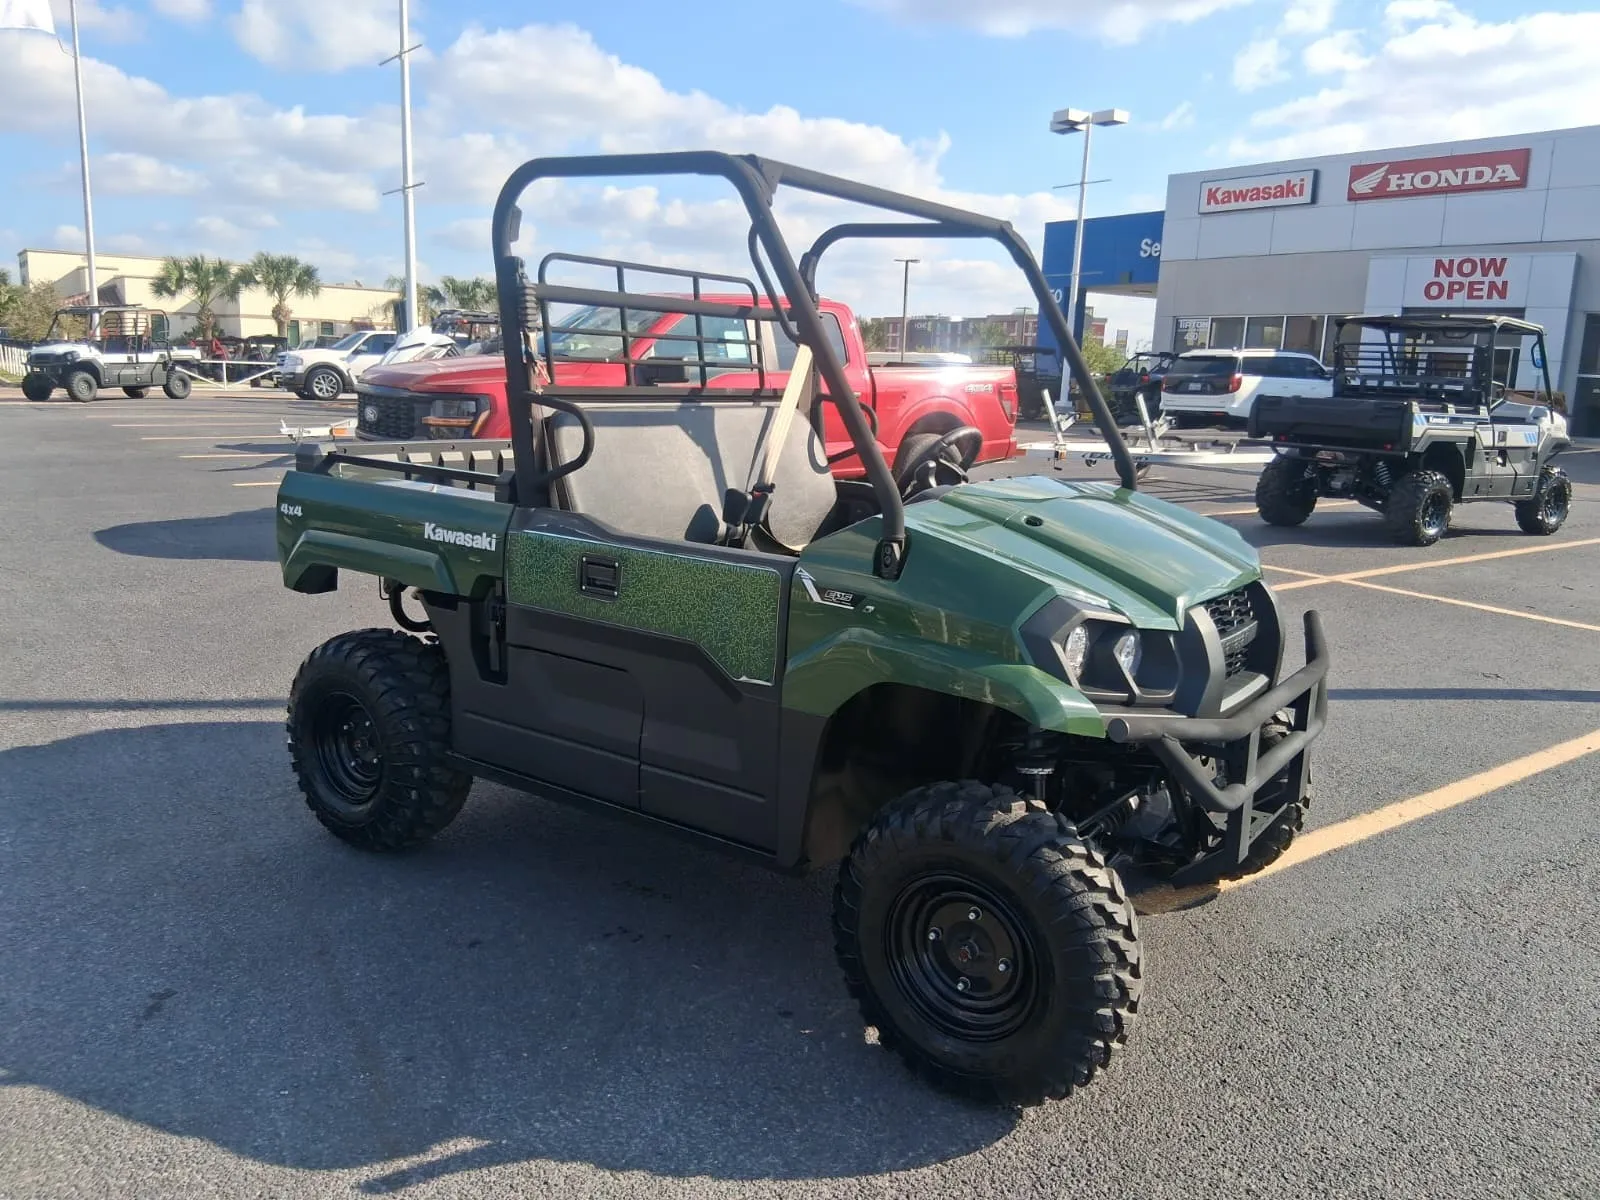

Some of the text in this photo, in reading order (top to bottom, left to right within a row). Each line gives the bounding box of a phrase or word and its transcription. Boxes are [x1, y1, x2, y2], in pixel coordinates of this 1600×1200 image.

[1386, 164, 1520, 192] HONDA
[1205, 177, 1305, 206] Kawasaki
[1434, 257, 1508, 278] NOW
[1424, 280, 1509, 300] OPEN
[280, 503, 303, 517] 4x4
[424, 522, 497, 552] Kawasaki
